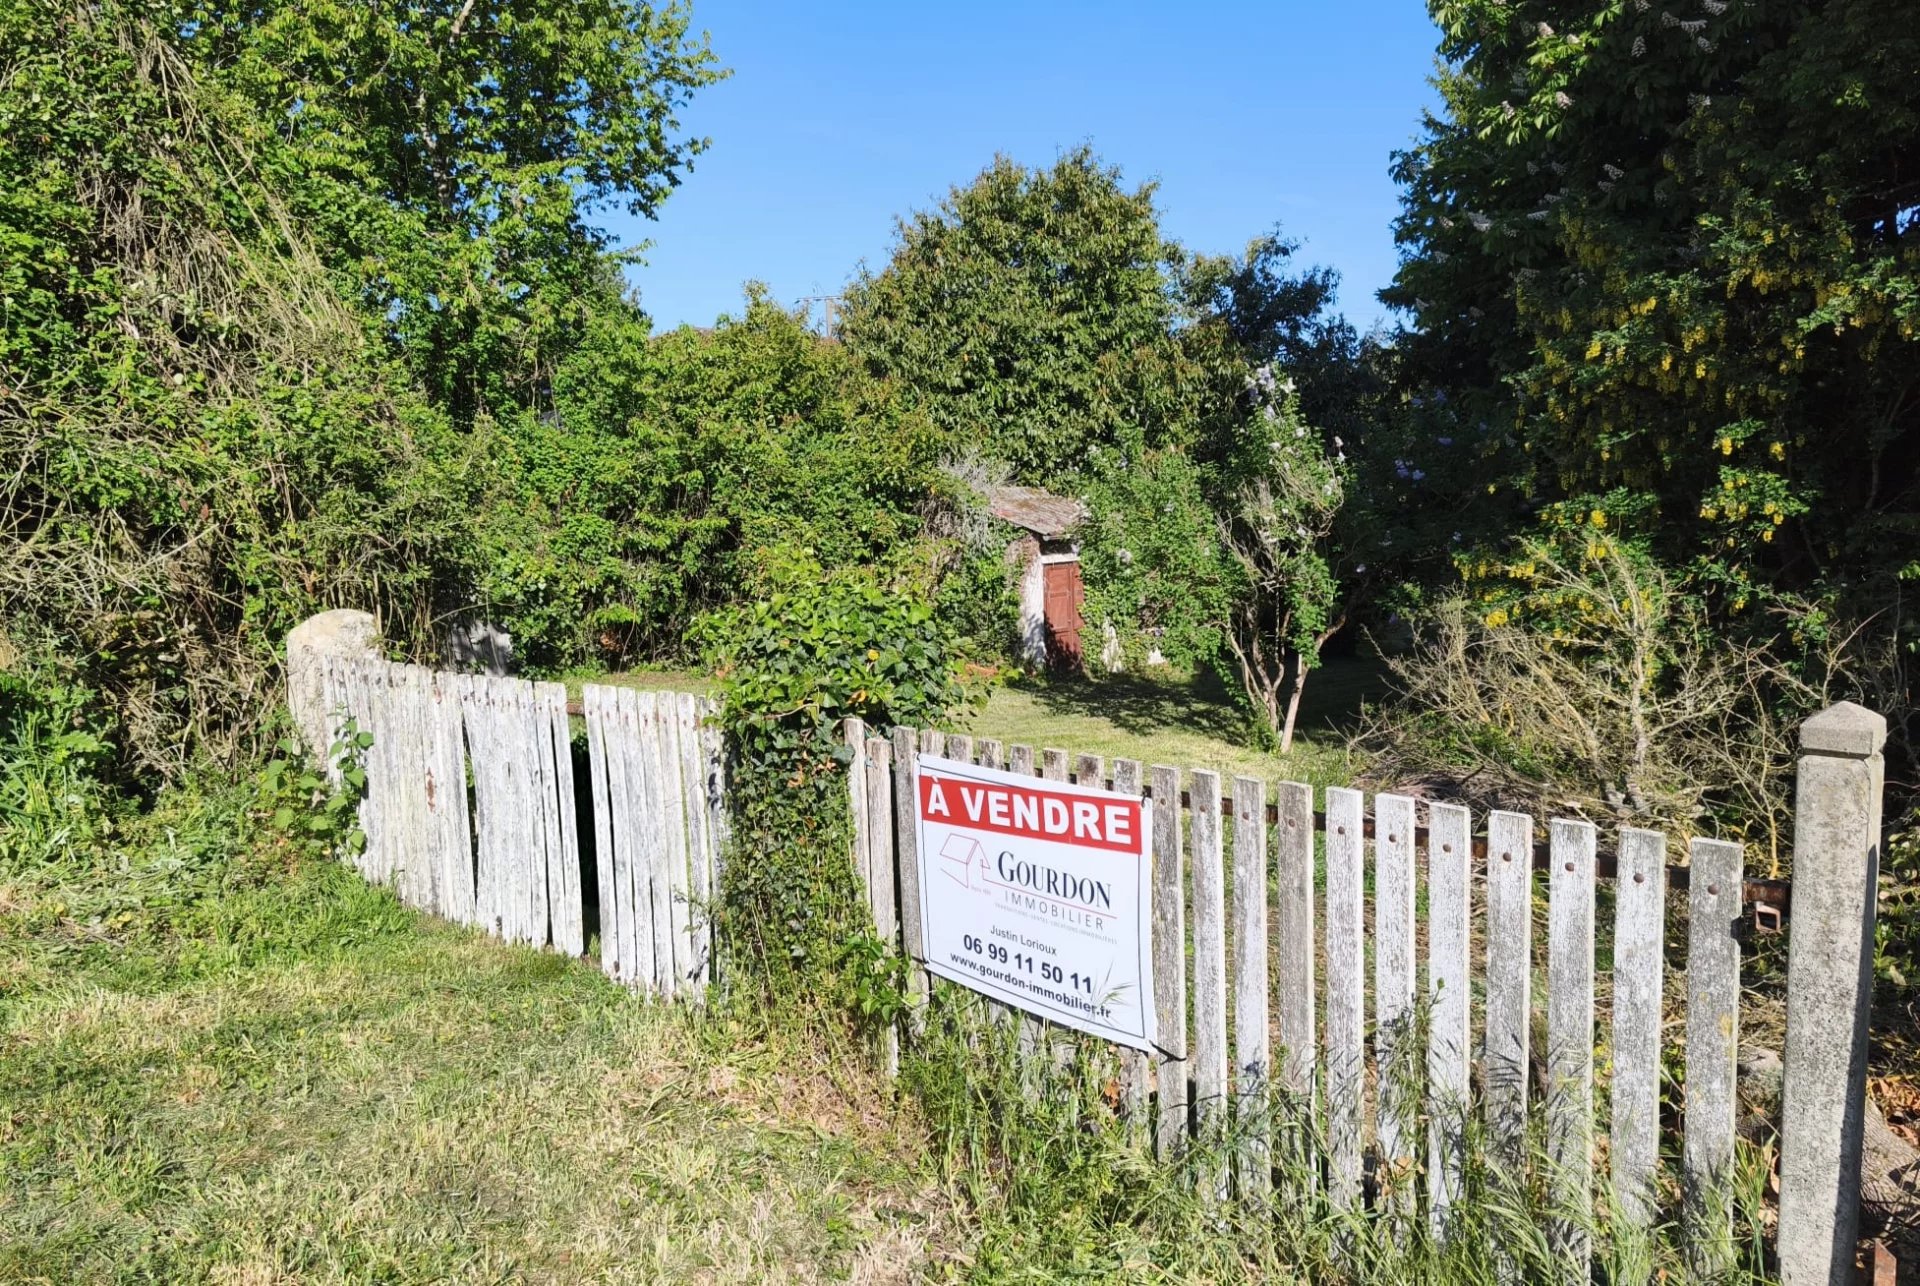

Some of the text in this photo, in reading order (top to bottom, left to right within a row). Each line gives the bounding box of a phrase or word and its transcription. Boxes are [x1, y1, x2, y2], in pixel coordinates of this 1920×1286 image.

[927, 777, 1132, 845] À VENDRE
[997, 850, 1112, 910] GOURDON
[990, 925, 1058, 956] Justin Lorioux
[1004, 890, 1104, 931] IMMOBILIER
[963, 934, 1091, 994] 06 99 11 50 11
